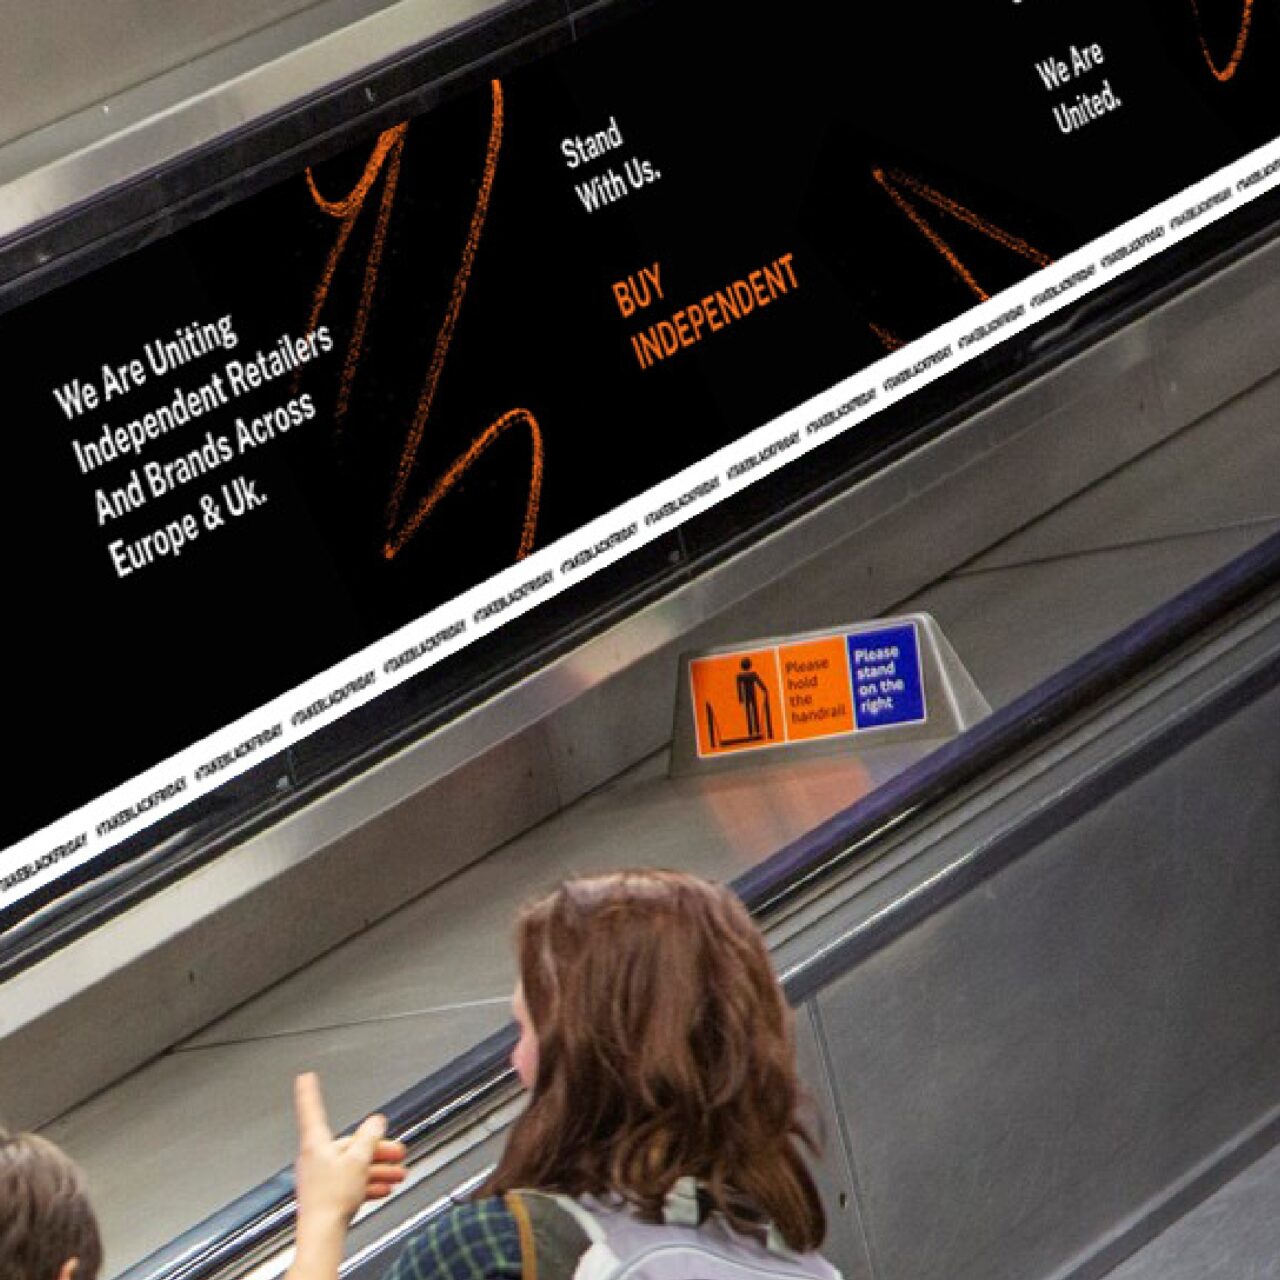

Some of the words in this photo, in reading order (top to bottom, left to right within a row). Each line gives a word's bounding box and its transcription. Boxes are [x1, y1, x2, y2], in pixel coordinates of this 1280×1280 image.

[1035, 57, 1070, 90] We
[1070, 44, 1103, 76] Are
[1052, 80, 1121, 133] United.
[560, 116, 623, 168] Stand
[575, 169, 627, 212] With
[624, 157, 661, 188] Us.
[612, 262, 663, 318] BUY
[631, 253, 798, 369] INDEPENDENT
[53, 379, 99, 419] We
[102, 359, 146, 401] Are
[144, 315, 238, 375] Uniting
[73, 373, 228, 472] Independent
[225, 326, 333, 397] Retailers
[95, 470, 146, 525] And
[143, 432, 232, 497] Brands
[236, 394, 316, 454] Across
[108, 514, 199, 578] Europe
[200, 494, 224, 530] &
[221, 476, 267, 516] Uk.
[855, 646, 899, 664] Please
[857, 660, 895, 680] stand
[787, 676, 818, 690] hold
[789, 694, 812, 707] the
[860, 683, 878, 695] on
[880, 679, 905, 693] the
[862, 696, 893, 715] right
